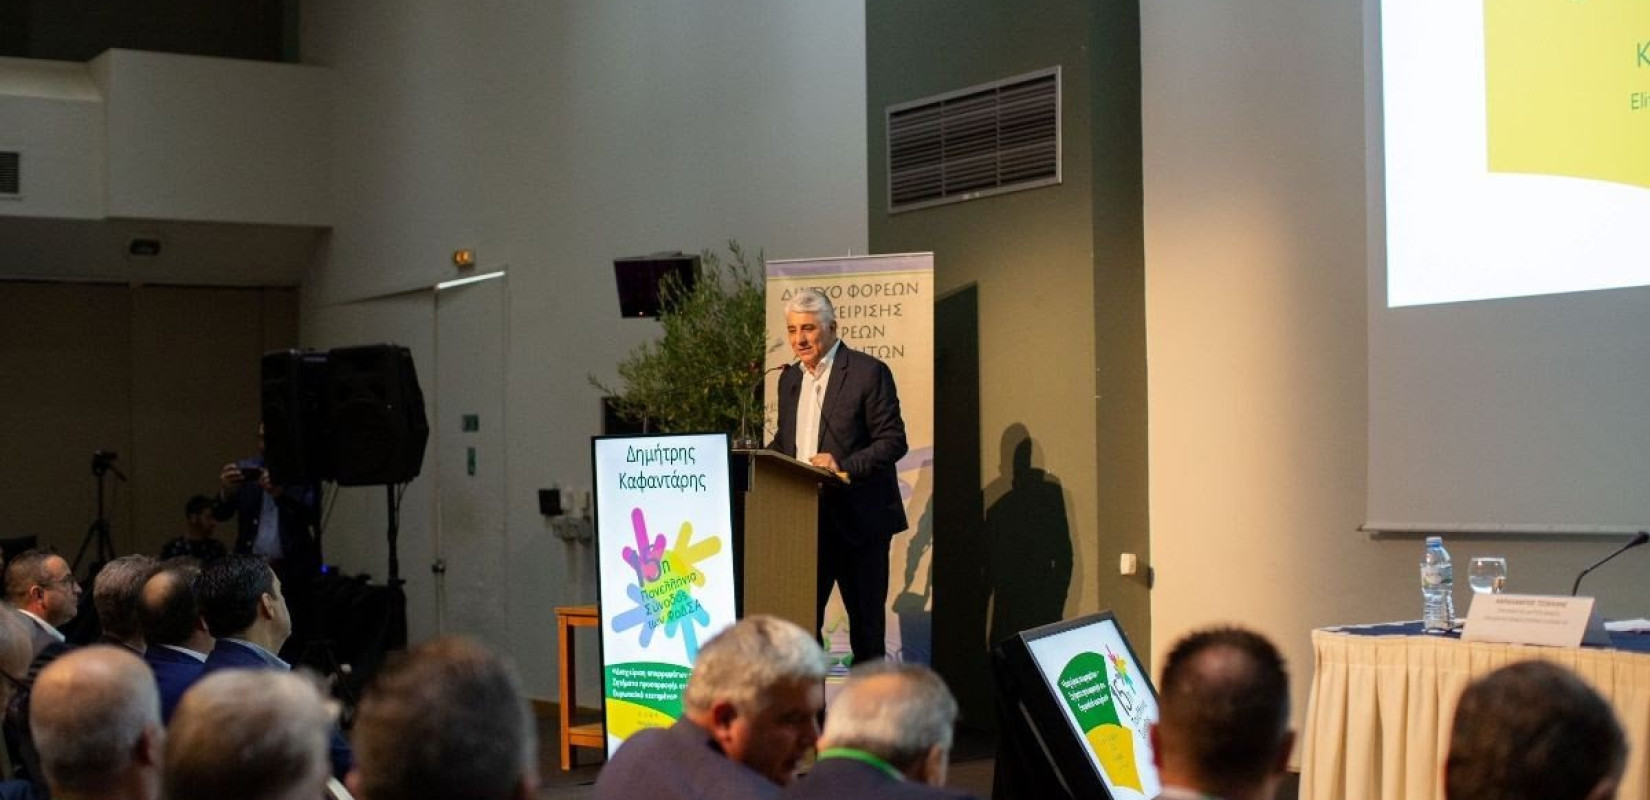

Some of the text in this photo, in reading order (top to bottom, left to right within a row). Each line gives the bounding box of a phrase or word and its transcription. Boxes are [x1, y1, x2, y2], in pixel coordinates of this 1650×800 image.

[1631, 91, 1650, 110] Eli
[781, 282, 919, 301] ΔΙΤΥΟ ΦΟΡΕΩΝ
[835, 303, 903, 319] ΕΙΡΙΣΗΣ
[841, 325, 885, 339] ΡΕΩΝ
[626, 443, 696, 466] Δημήτρης
[619, 470, 706, 493] Καφαντάρης
